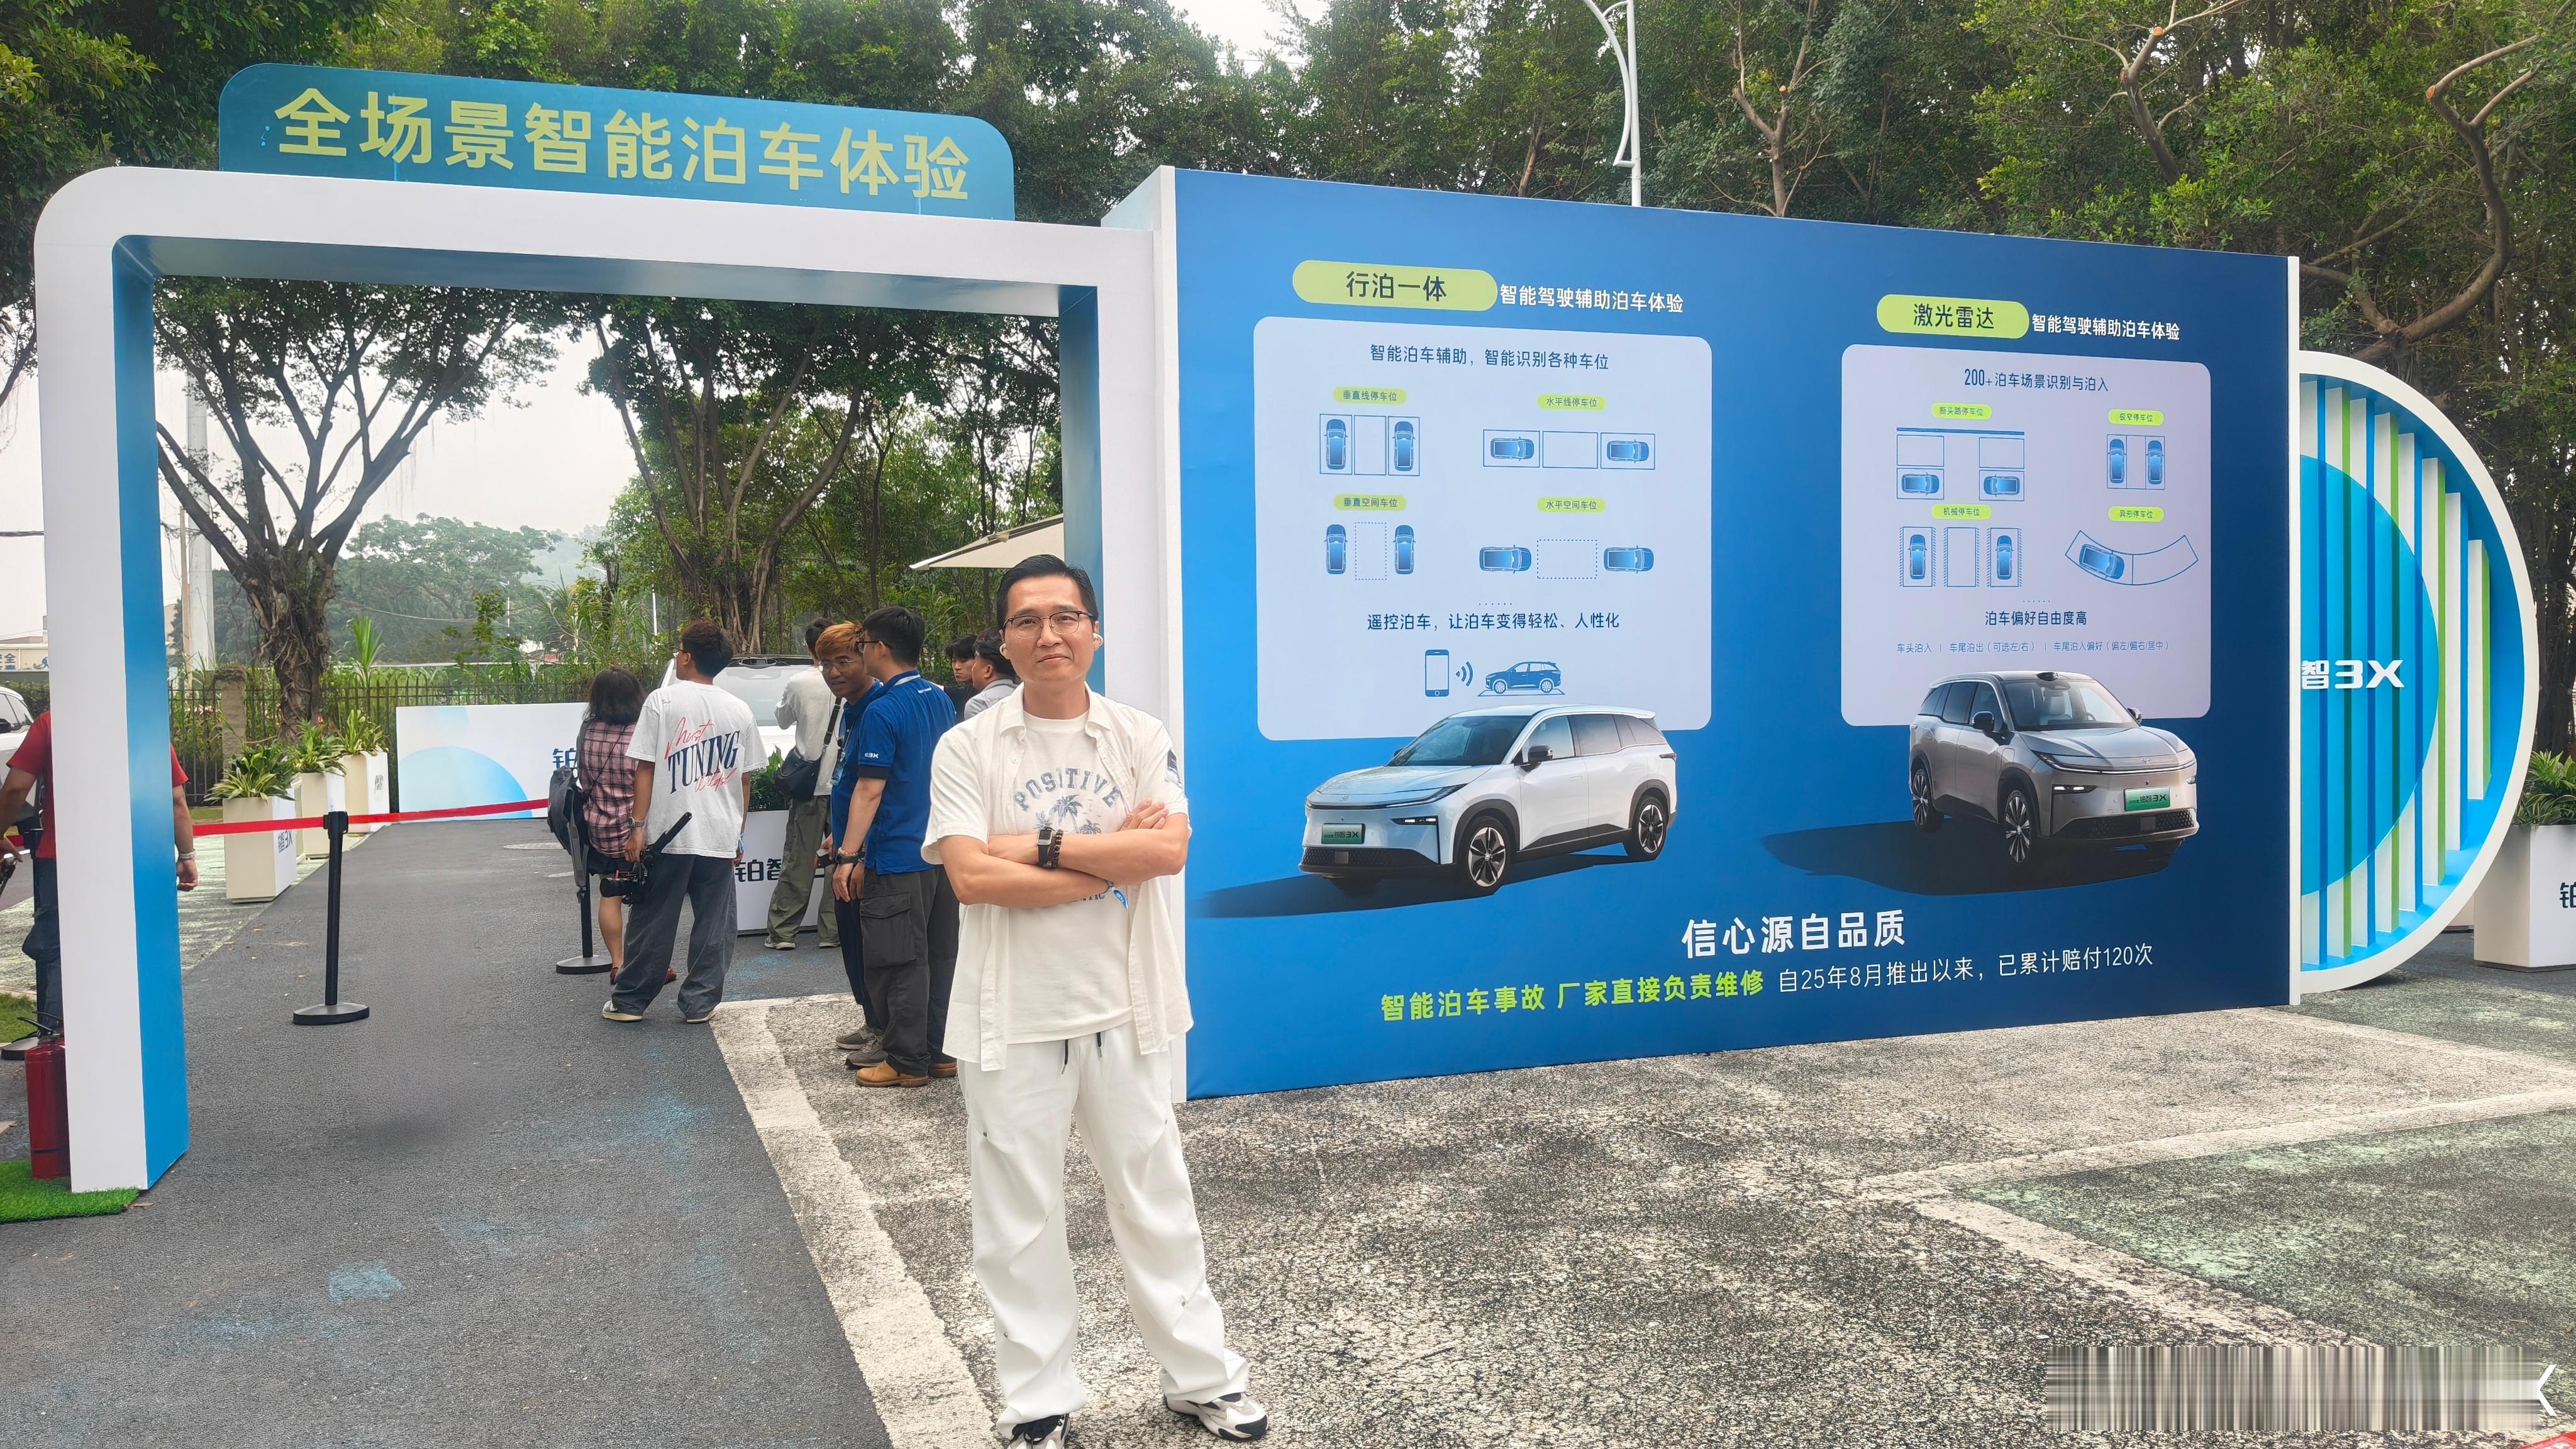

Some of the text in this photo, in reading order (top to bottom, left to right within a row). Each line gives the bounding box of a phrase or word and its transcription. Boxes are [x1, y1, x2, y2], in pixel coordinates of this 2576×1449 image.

[274, 87, 970, 200] 全场景智能泊车体验
[1346, 271, 1683, 313] 行泊一体 智能驾驶辅助泊车体验
[1913, 303, 2179, 340] 激光雷达 智能驾驶辅助泊车体验
[1371, 344, 1608, 369] 智能泊车辅助，智能识别各种车位
[1965, 369, 2108, 391] 200+泊车场景识别与泊入
[1343, 391, 1397, 401] 垂直线停车位
[1546, 397, 1596, 407] 水平线停车位
[1940, 406, 1983, 416] 断头路停车位
[1344, 498, 1397, 507] 垂直空间车位
[1546, 500, 1596, 509] 水平空间车位
[1943, 508, 1979, 516] 机械停车位
[1368, 613, 1619, 630] 遥控泊车，让泊车变得轻松、人性化
[1985, 611, 2087, 626] 泊车偏好自由度高
[669, 730, 740, 794] TUNING
[1013, 767, 1122, 812] POSITIVE
[1682, 909, 1906, 959] 信心源自品质
[1382, 984, 1545, 1021] 智能泊车事故
[1558, 970, 1763, 1008] 厂家直接负责维修
